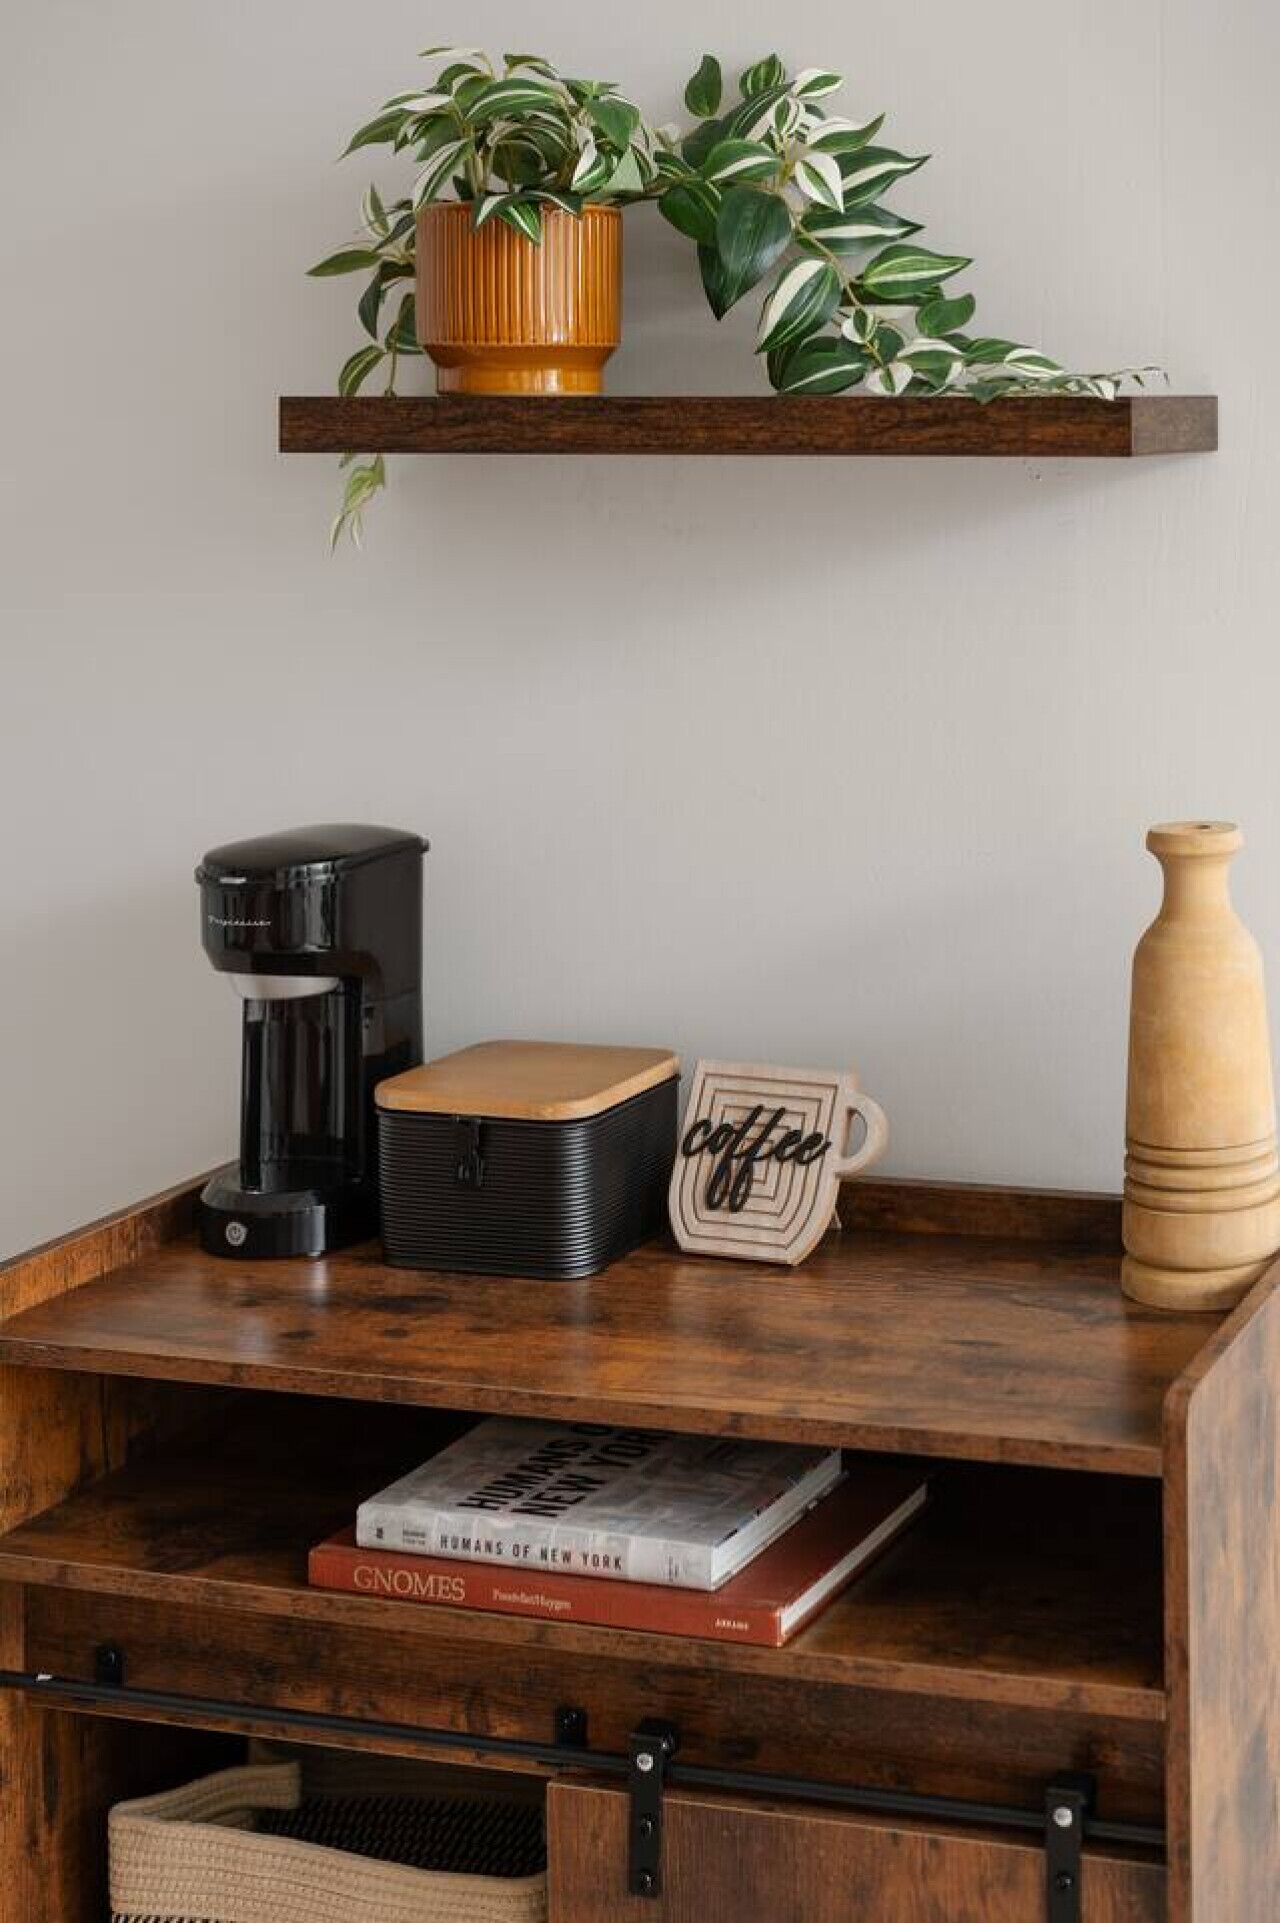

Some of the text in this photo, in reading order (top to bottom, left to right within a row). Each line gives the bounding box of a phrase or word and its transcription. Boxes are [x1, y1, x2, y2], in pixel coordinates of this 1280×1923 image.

[682, 1104, 832, 1213] coffee
[456, 1439, 591, 1511] HUMANS
[509, 1431, 669, 1518] NEW YOR
[353, 1565, 466, 1602] GNOMES
[440, 1533, 504, 1556] HUMANS
[512, 1543, 530, 1559] OF
[540, 1547, 573, 1563] NEW
[582, 1551, 622, 1571] YORK
